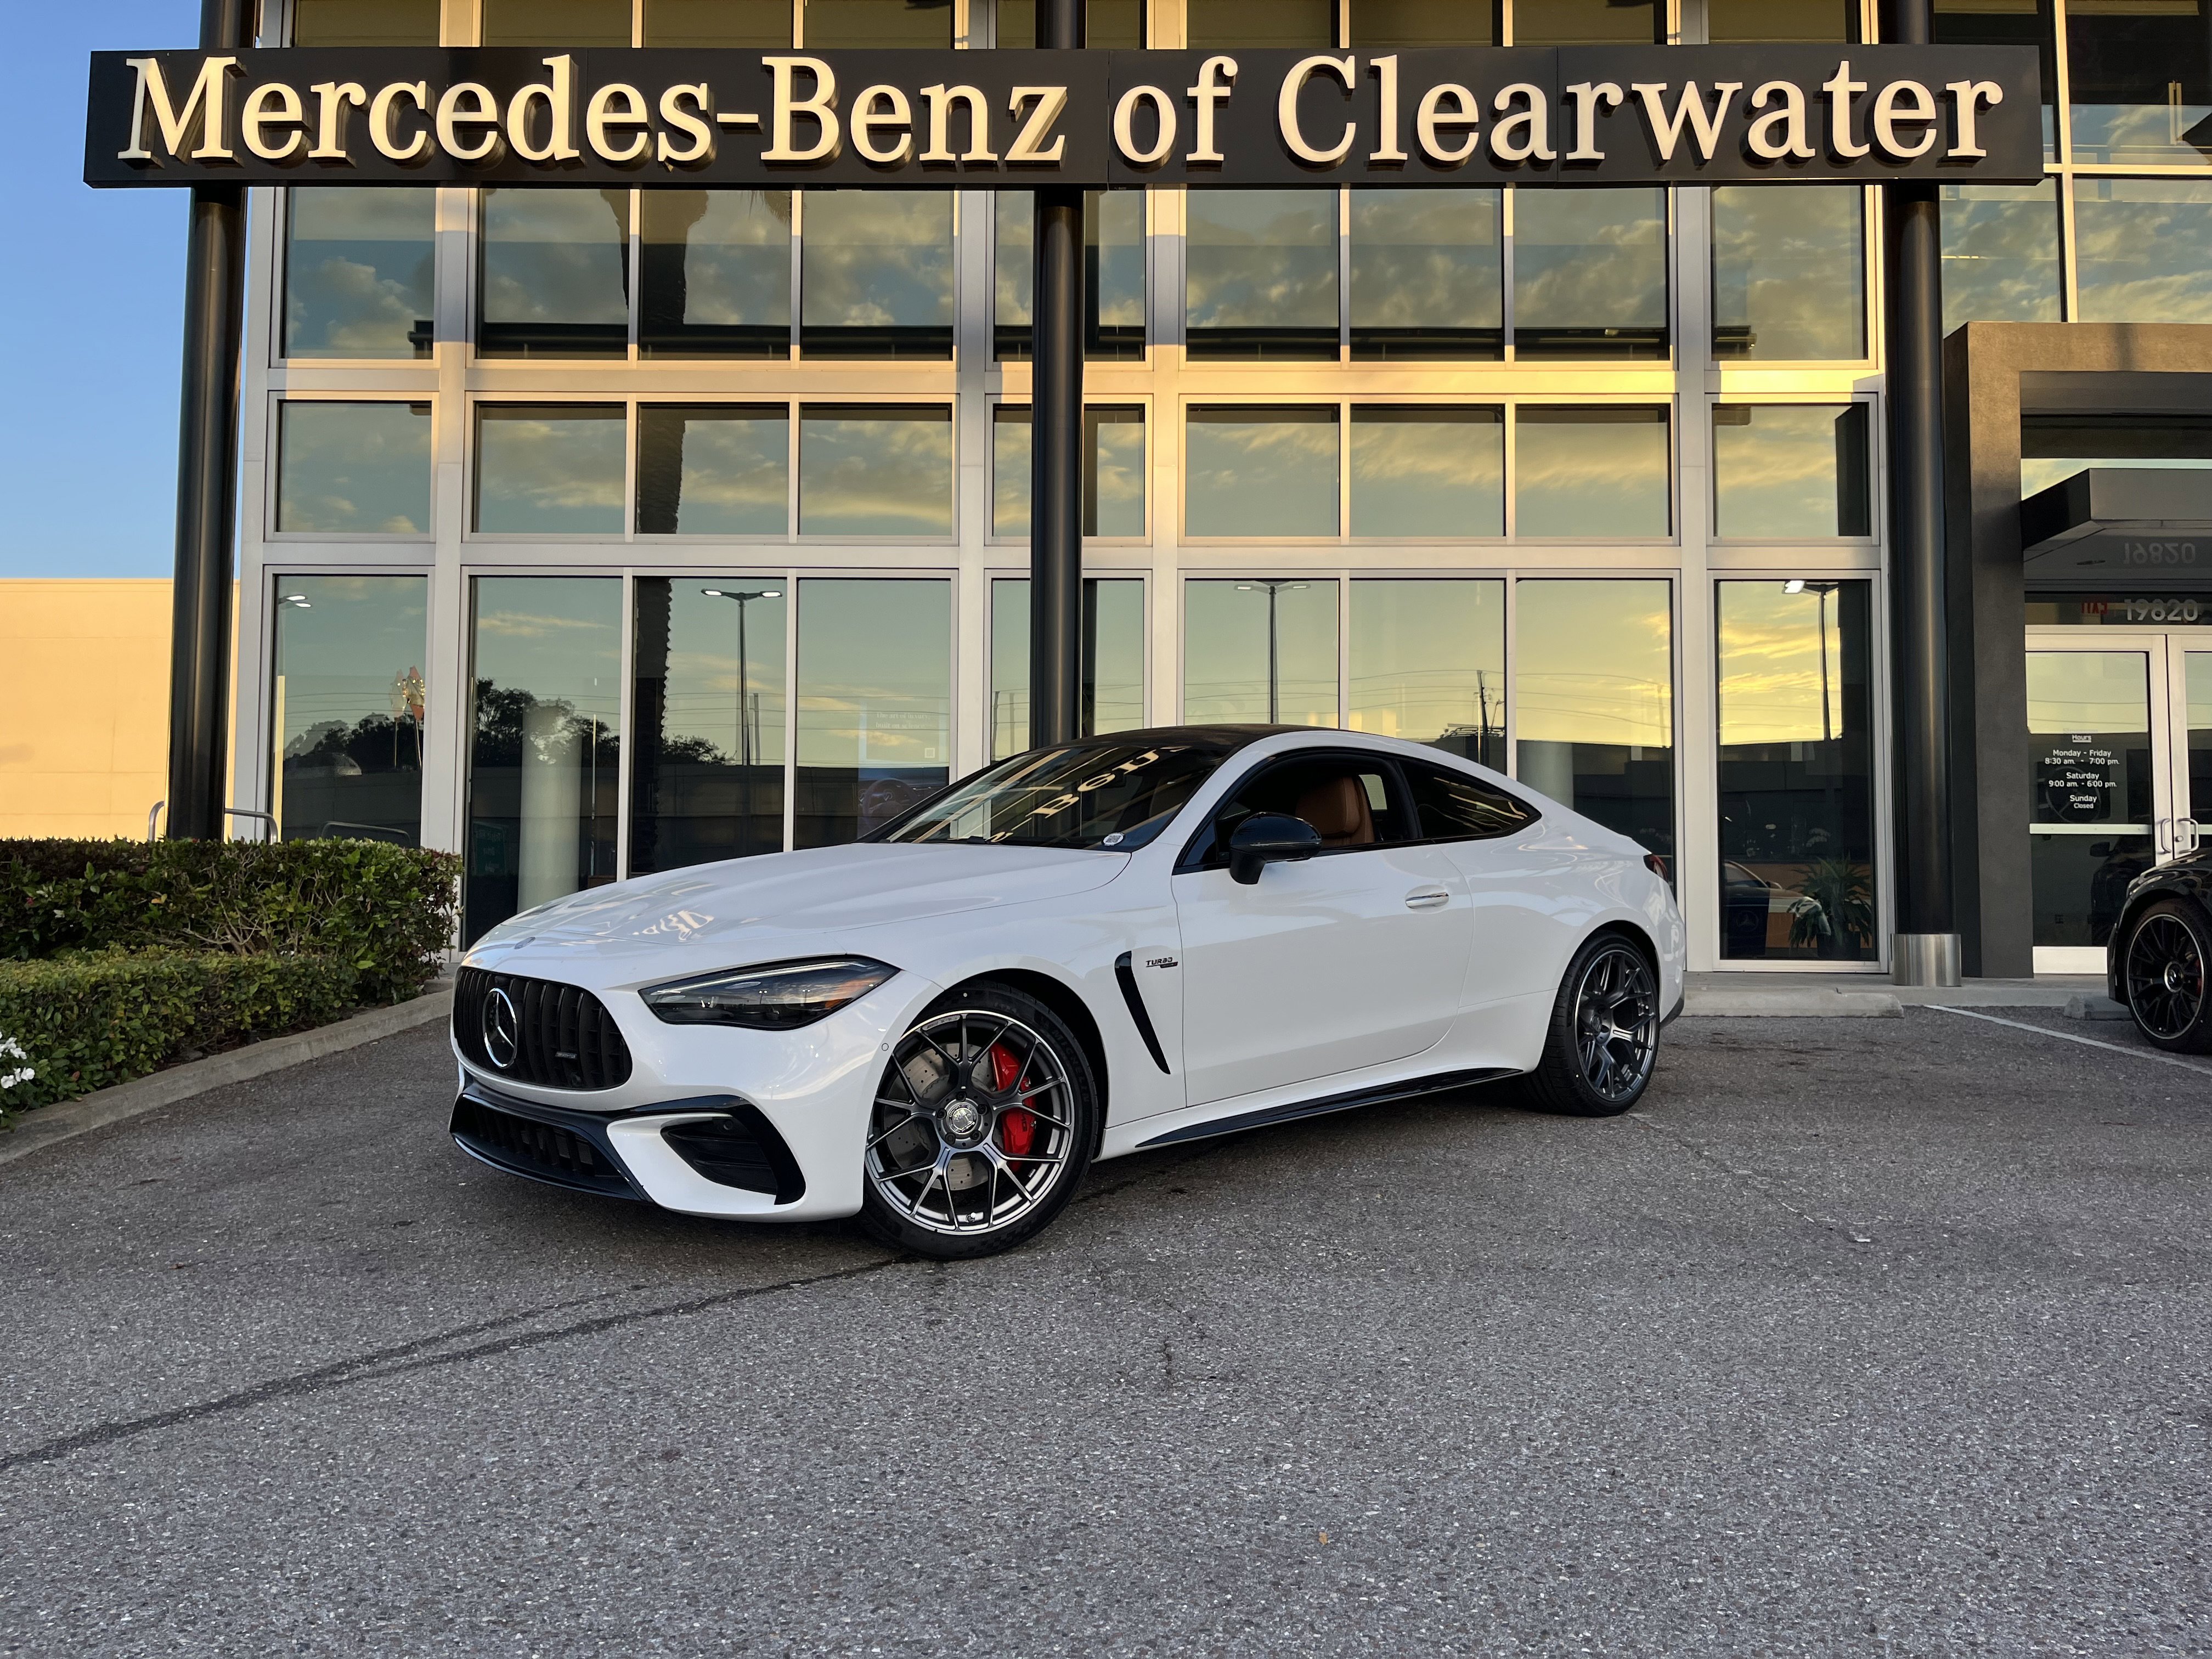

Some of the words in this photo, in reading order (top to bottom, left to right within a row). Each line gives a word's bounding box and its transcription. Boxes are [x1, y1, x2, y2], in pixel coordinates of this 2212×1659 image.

[117, 54, 1068, 162] Mercedes-Benz
[1113, 55, 1239, 163] of
[1278, 54, 2004, 162] Clearwater
[2123, 598, 2198, 622] 19820
[2066, 772, 2100, 780] Saturday
[2069, 794, 2097, 803] Sunday
[1146, 957, 1173, 966] TURBO
